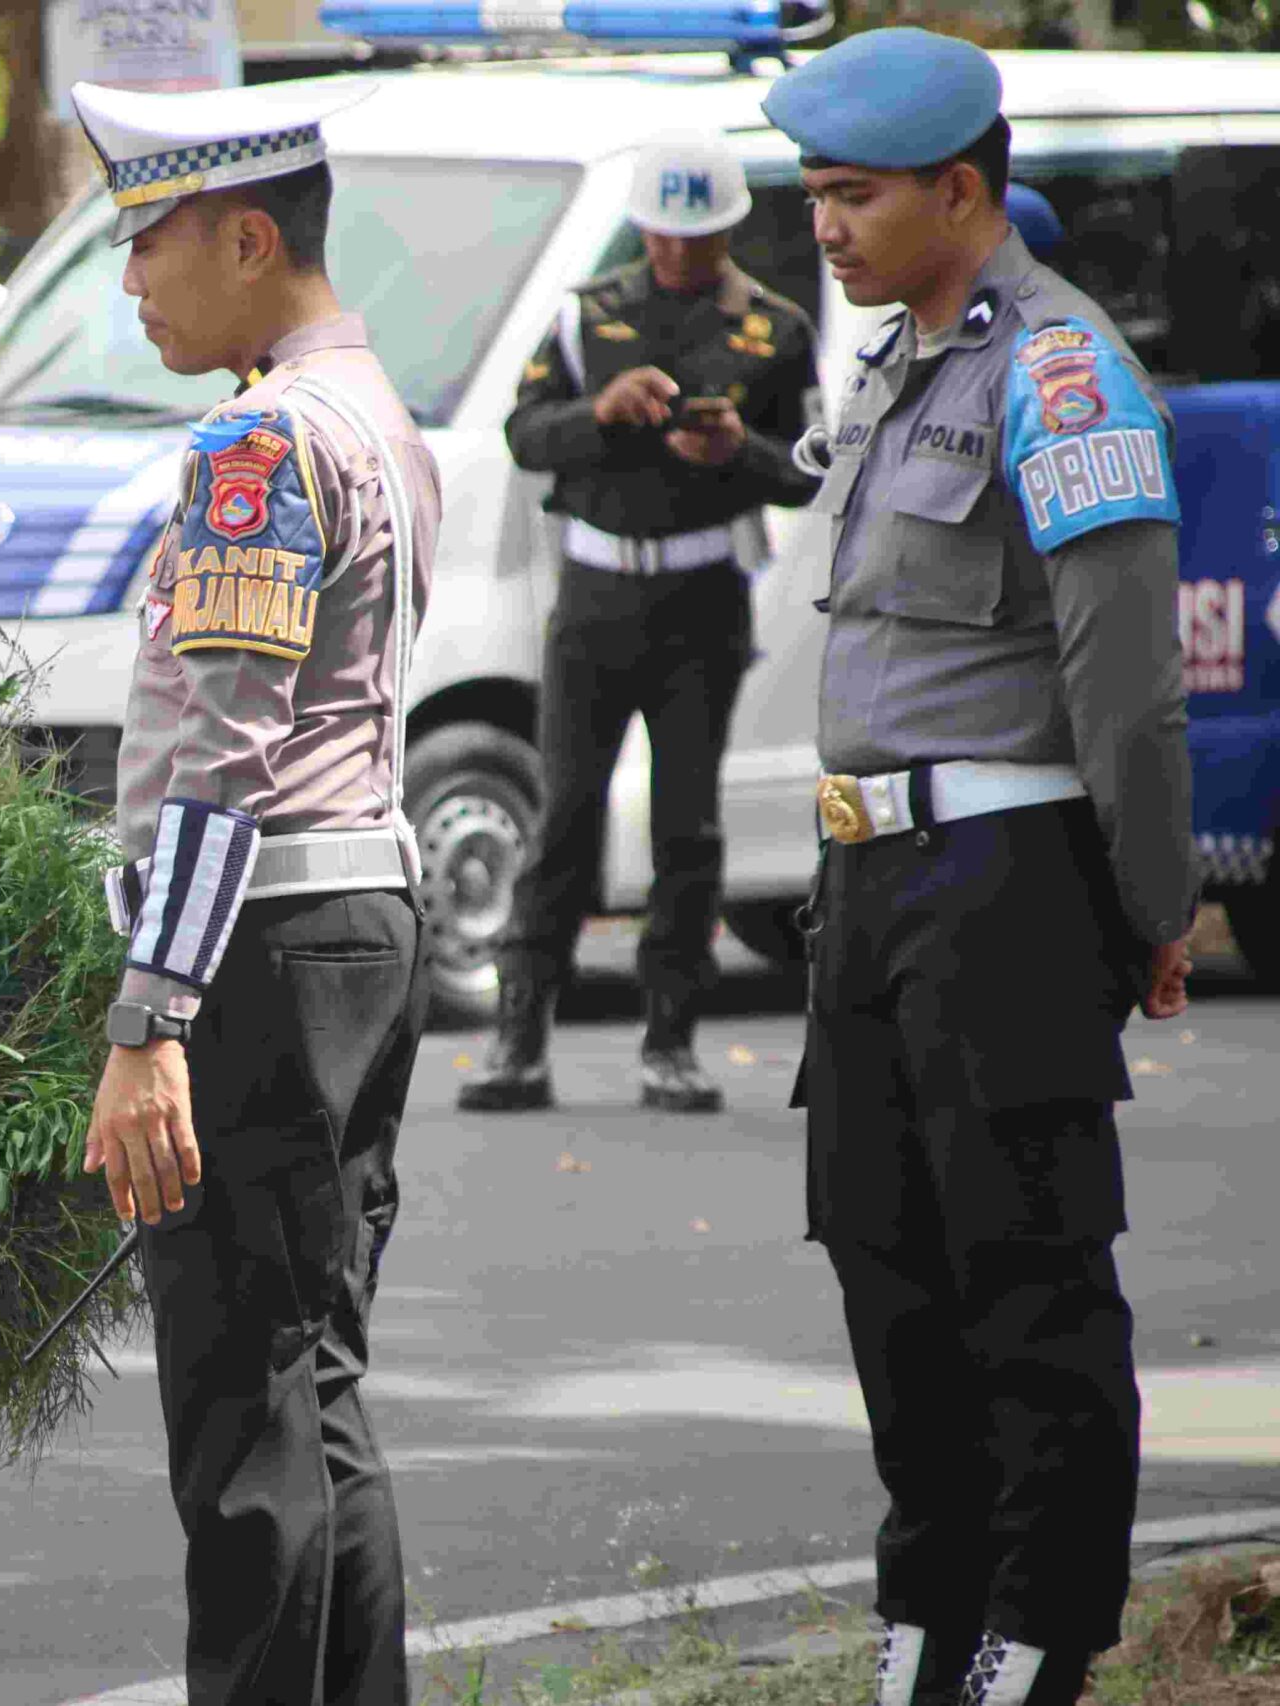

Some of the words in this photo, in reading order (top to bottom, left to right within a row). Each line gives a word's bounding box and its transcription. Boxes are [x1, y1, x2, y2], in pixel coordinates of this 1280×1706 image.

[919, 423, 984, 458] POLRI
[1018, 429, 1166, 531] PROV
[176, 546, 307, 581] KANIT
